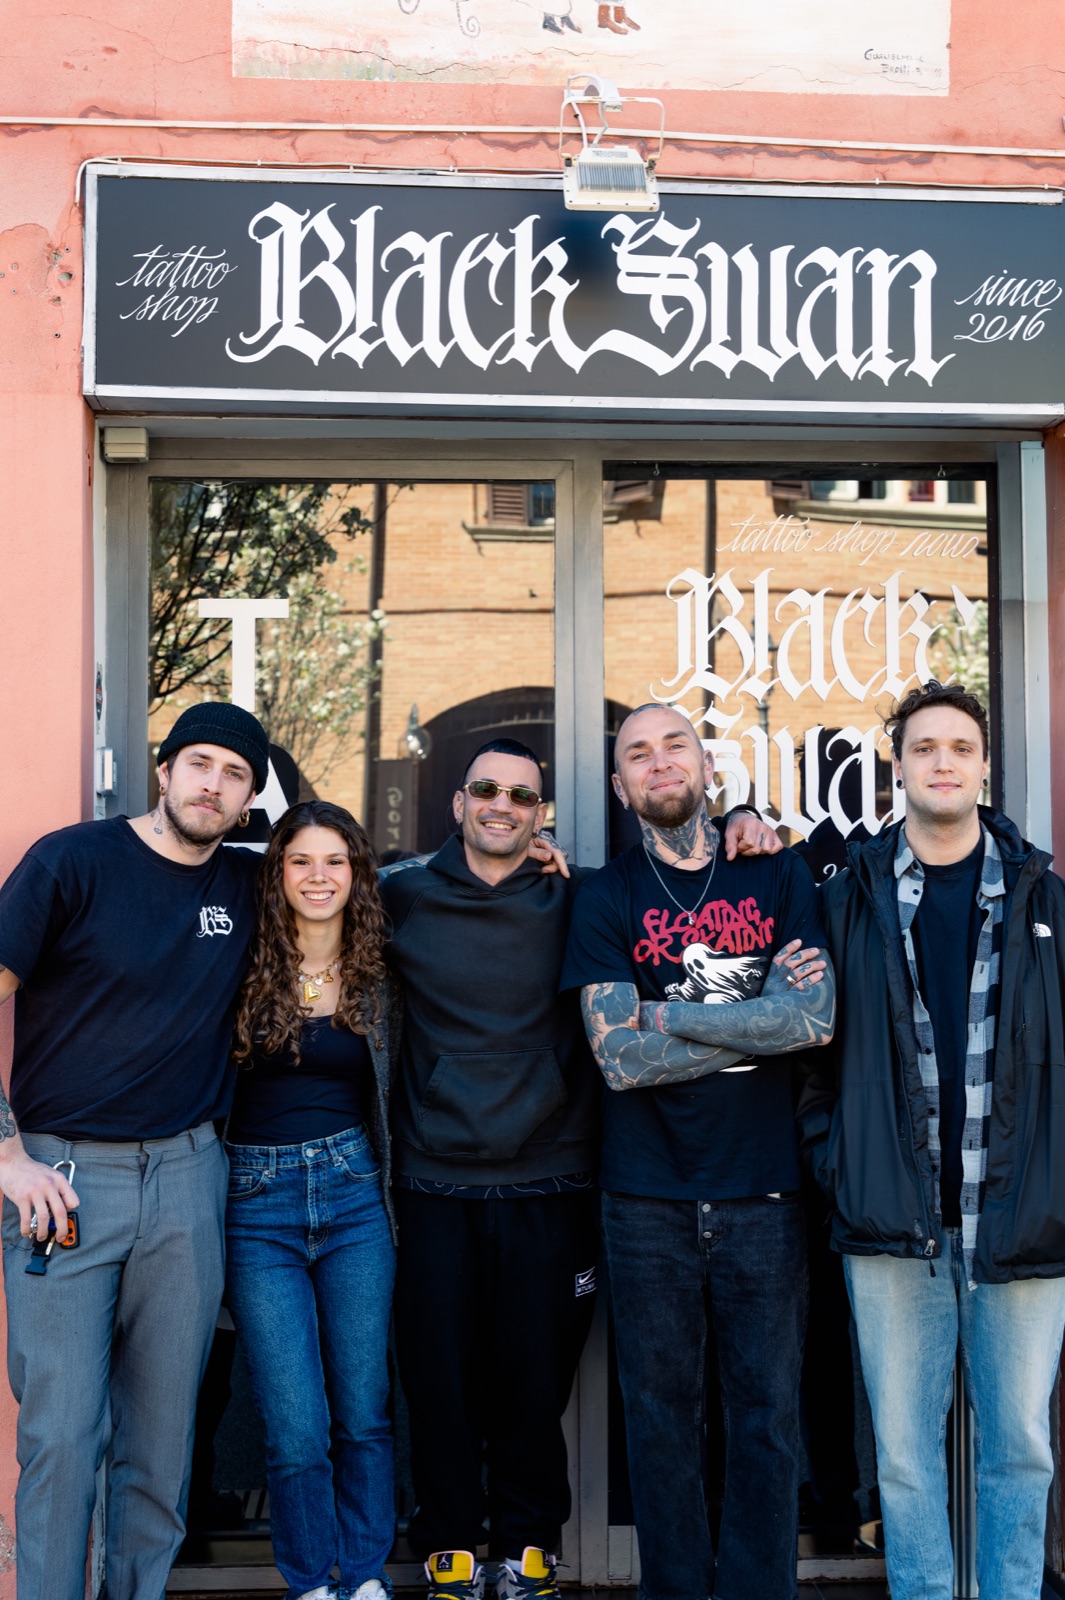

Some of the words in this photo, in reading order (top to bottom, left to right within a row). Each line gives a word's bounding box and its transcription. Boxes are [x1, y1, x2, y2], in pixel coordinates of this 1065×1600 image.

[115, 244, 238, 289] tattoo
[954, 269, 1063, 308] since
[120, 285, 219, 338] shop
[225, 201, 589, 374] Black
[585, 211, 956, 387] Swan
[953, 308, 1052, 343] 2016
[716, 513, 820, 553] tattoo
[814, 520, 899, 567] shop
[649, 567, 958, 703] Black
[671, 700, 906, 843] Swa
